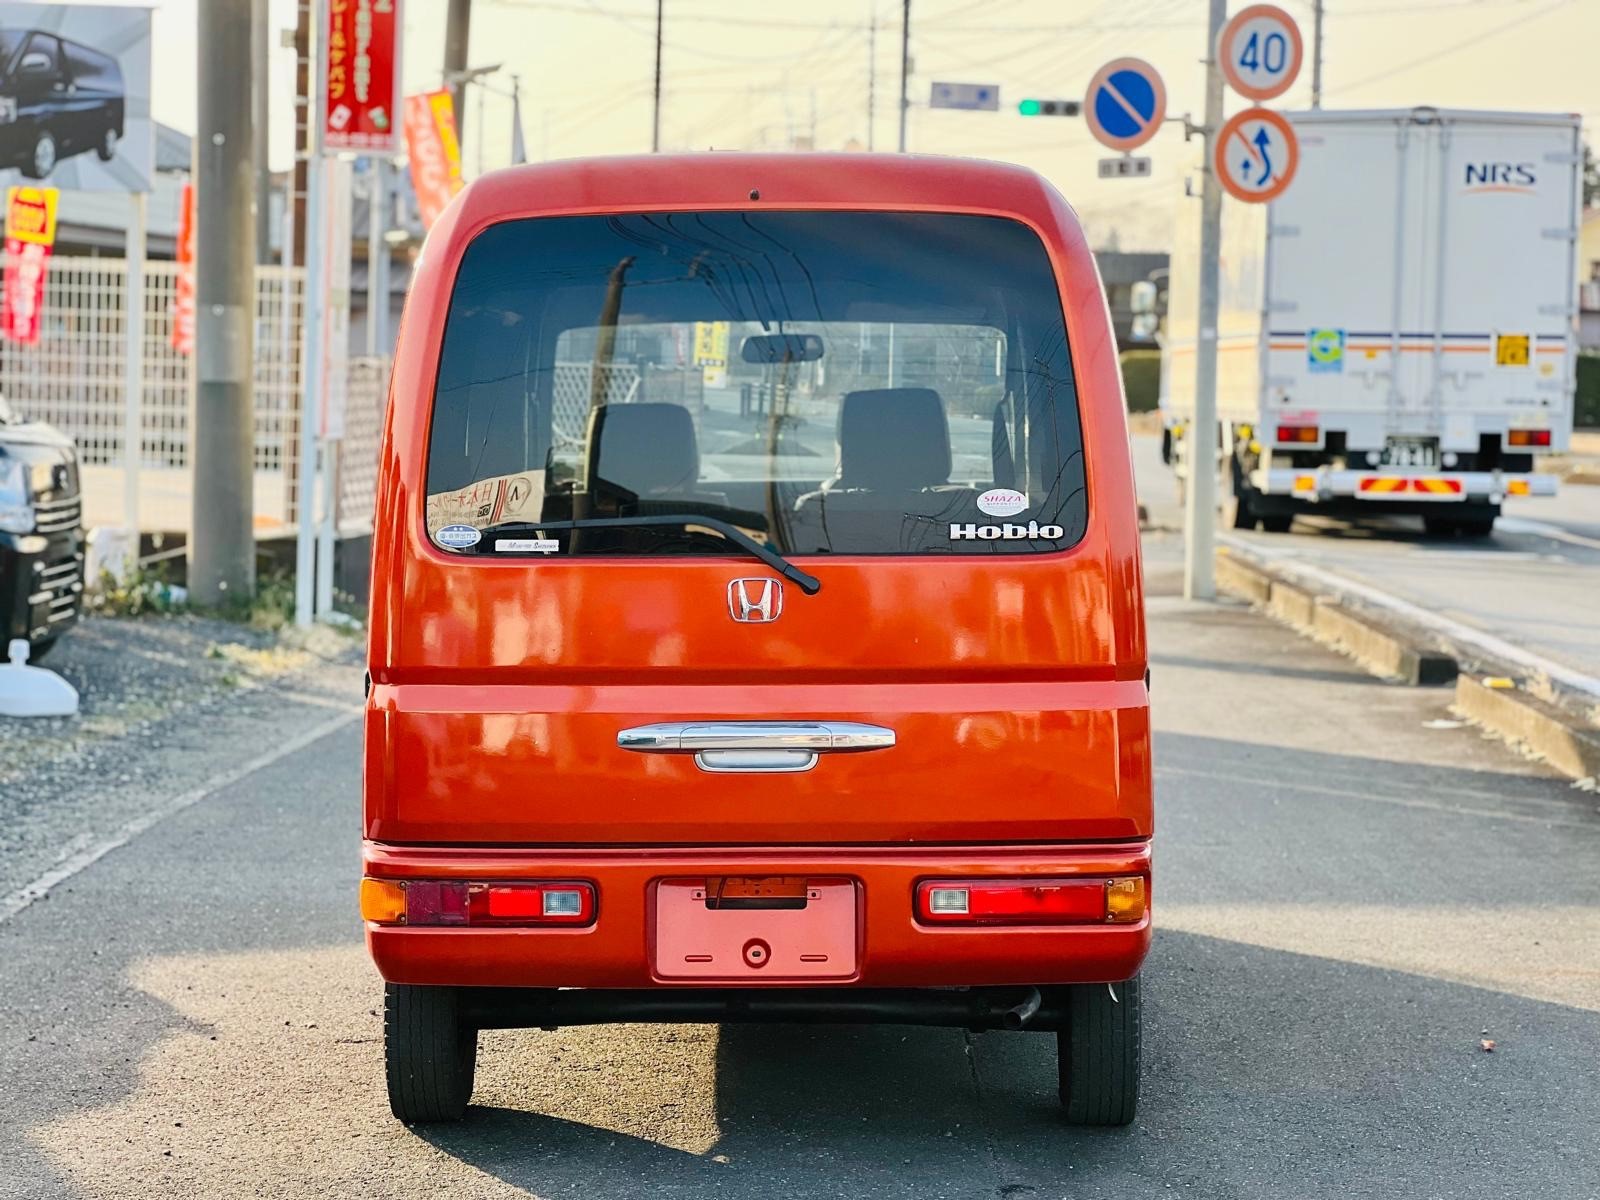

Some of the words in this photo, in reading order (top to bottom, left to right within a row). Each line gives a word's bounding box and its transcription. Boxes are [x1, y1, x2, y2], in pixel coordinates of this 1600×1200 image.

[1239, 32, 1286, 74] 40
[1465, 162, 1536, 185] NRS
[949, 519, 1064, 540] Hobio
